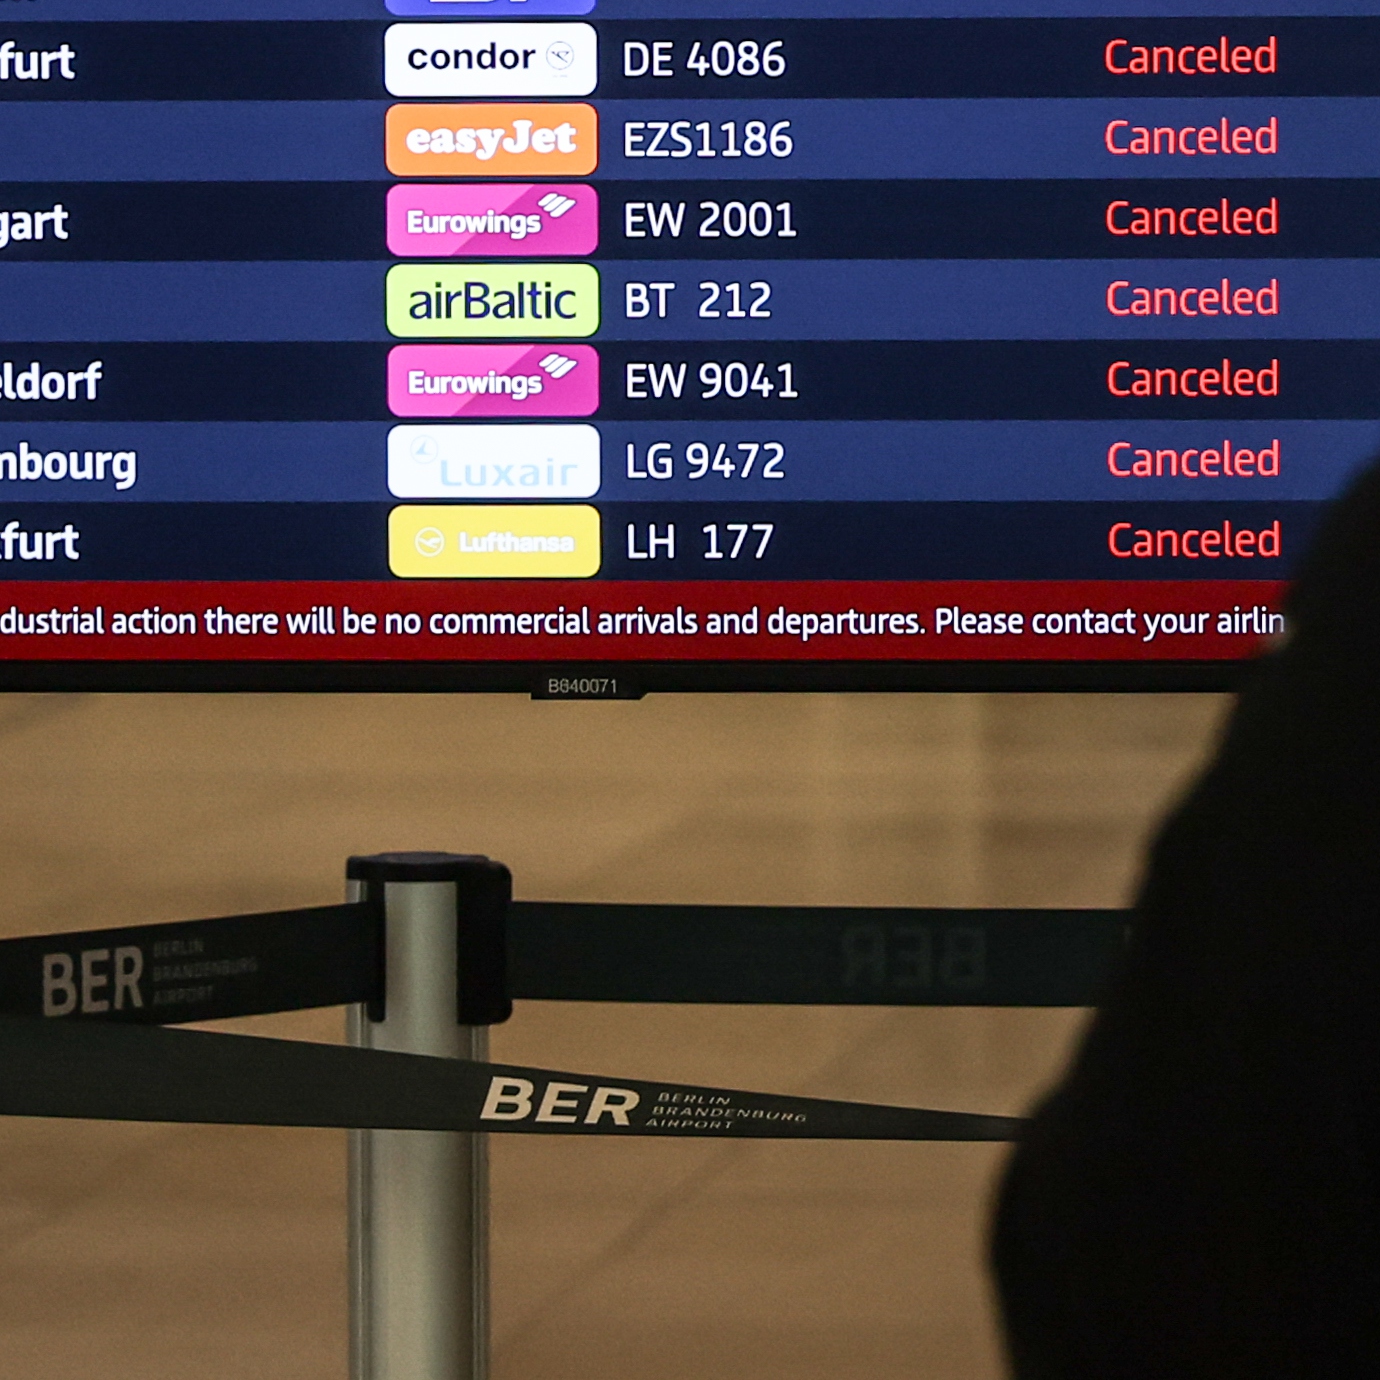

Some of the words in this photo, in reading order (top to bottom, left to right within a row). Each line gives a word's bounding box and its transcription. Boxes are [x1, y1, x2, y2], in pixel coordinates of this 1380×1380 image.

[408, 42, 536, 70] condor
[625, 121, 792, 157] EZS1186
[410, 281, 576, 319] airBaltic
[626, 283, 674, 317] BT
[700, 282, 770, 317] 212
[1107, 359, 1279, 397] Canceled
[628, 443, 672, 478] LG
[687, 443, 783, 478] 9472
[112, 607, 195, 634] action
[204, 607, 278, 634] there
[286, 607, 335, 634] will
[344, 607, 376, 634] be
[386, 614, 421, 634] no
[430, 607, 590, 634] commercial
[598, 607, 697, 634] arrivals
[707, 607, 757, 634] and
[768, 607, 925, 641] departures.
[936, 607, 1023, 634] Please
[1033, 609, 1136, 634] contact
[1143, 613, 1209, 641] your
[1218, 606, 1283, 633] airlin
[43, 946, 142, 1016] BER
[480, 1076, 640, 1126] BER
[651, 1105, 806, 1123] BRANDENBURG
[658, 1091, 731, 1105] BERLIN
[645, 1117, 733, 1130] AIRPORT
